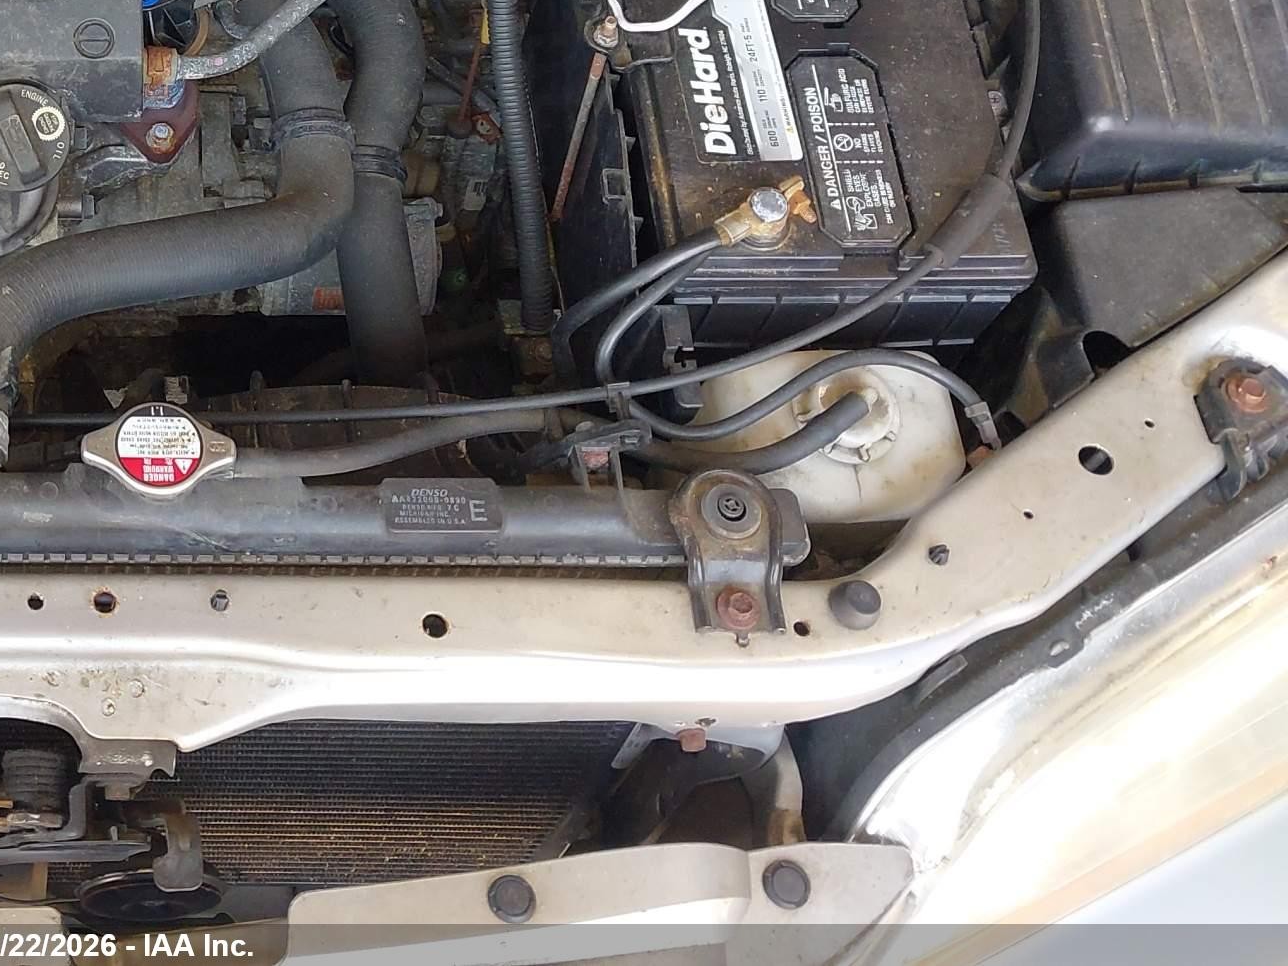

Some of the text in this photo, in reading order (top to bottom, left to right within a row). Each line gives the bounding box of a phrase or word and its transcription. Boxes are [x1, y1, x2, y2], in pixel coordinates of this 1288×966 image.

[21, 89, 48, 106] ENGINE
[676, 26, 737, 156] DieHard
[756, 89, 768, 101] 110
[802, 87, 825, 132] POISON
[766, 130, 779, 147] 600
[852, 137, 862, 148] NO
[52, 141, 64, 159] OIL
[815, 145, 839, 196] DANGER
[412, 488, 448, 497] DENSO
[470, 500, 488, 522] E
